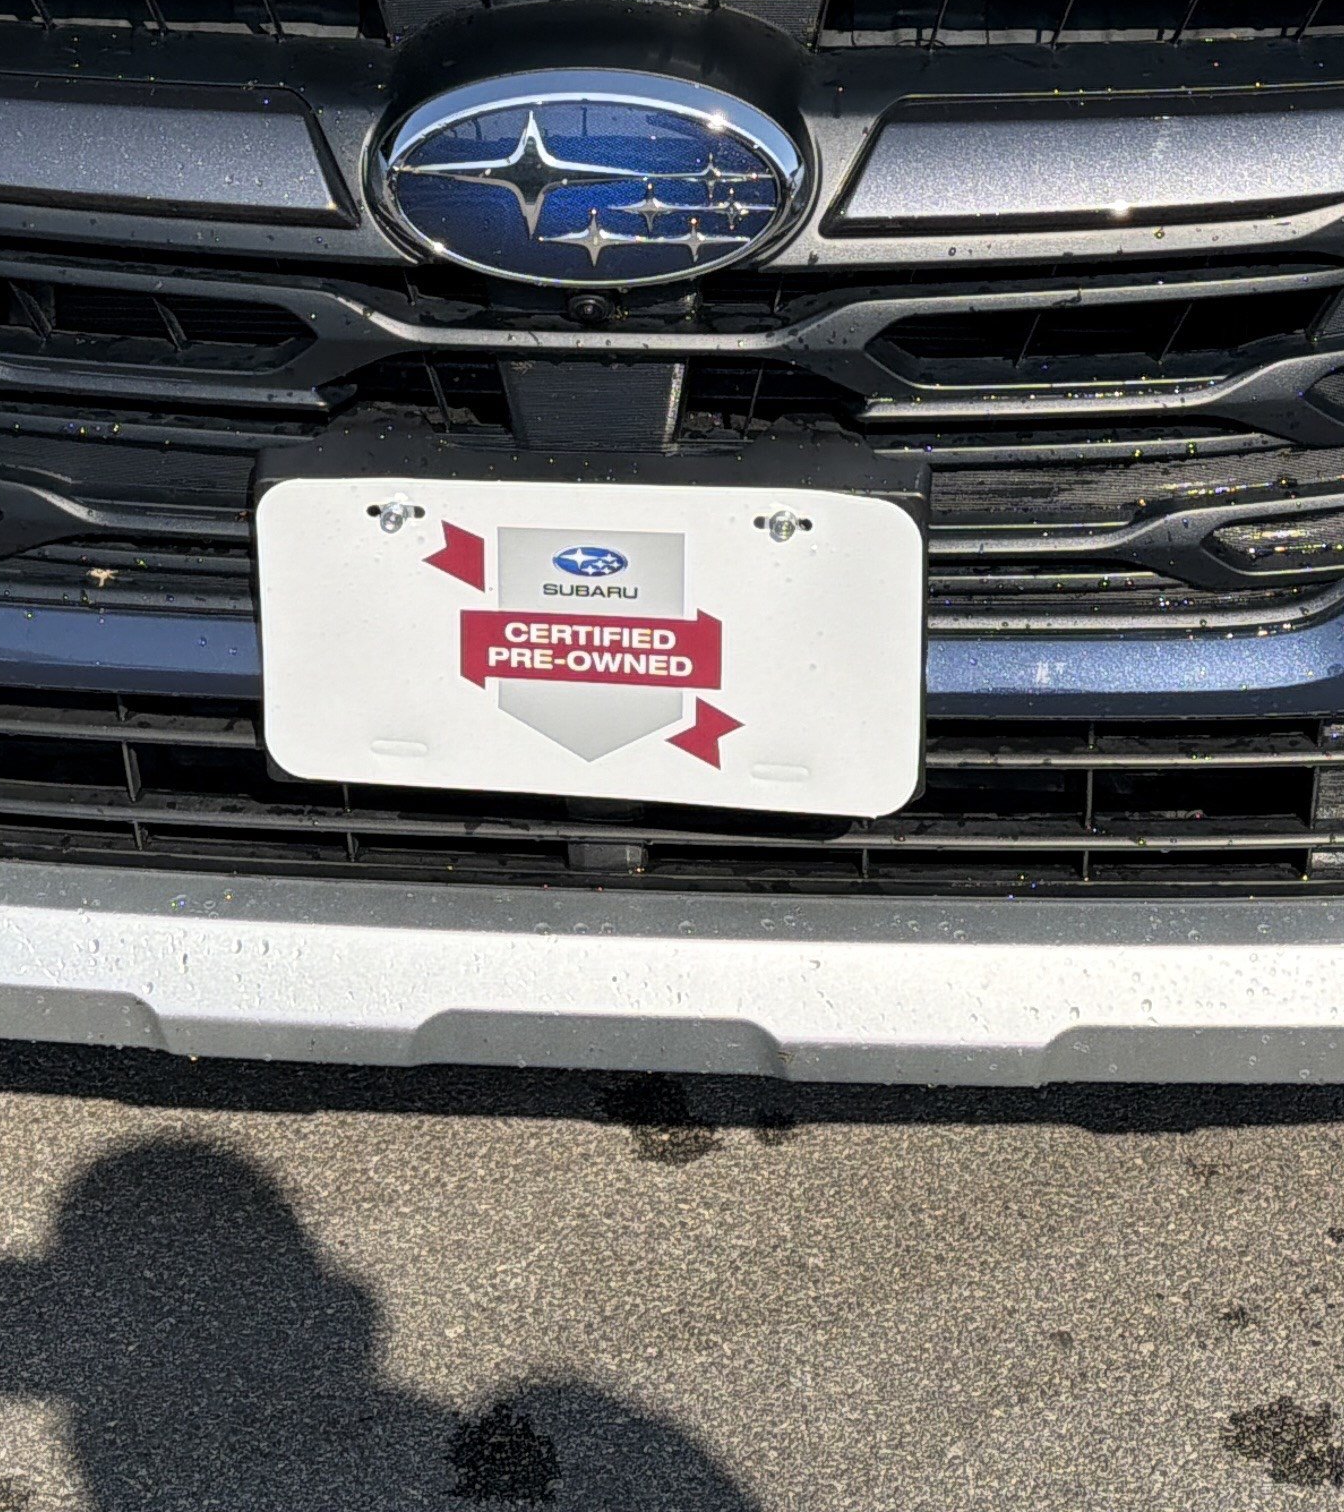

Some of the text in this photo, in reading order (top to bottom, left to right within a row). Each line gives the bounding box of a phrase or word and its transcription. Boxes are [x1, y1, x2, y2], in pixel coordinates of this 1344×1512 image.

[542, 582, 639, 600] SUBARU
[504, 621, 676, 650] CERTIFIED
[487, 646, 694, 677] PRE-OWNED
